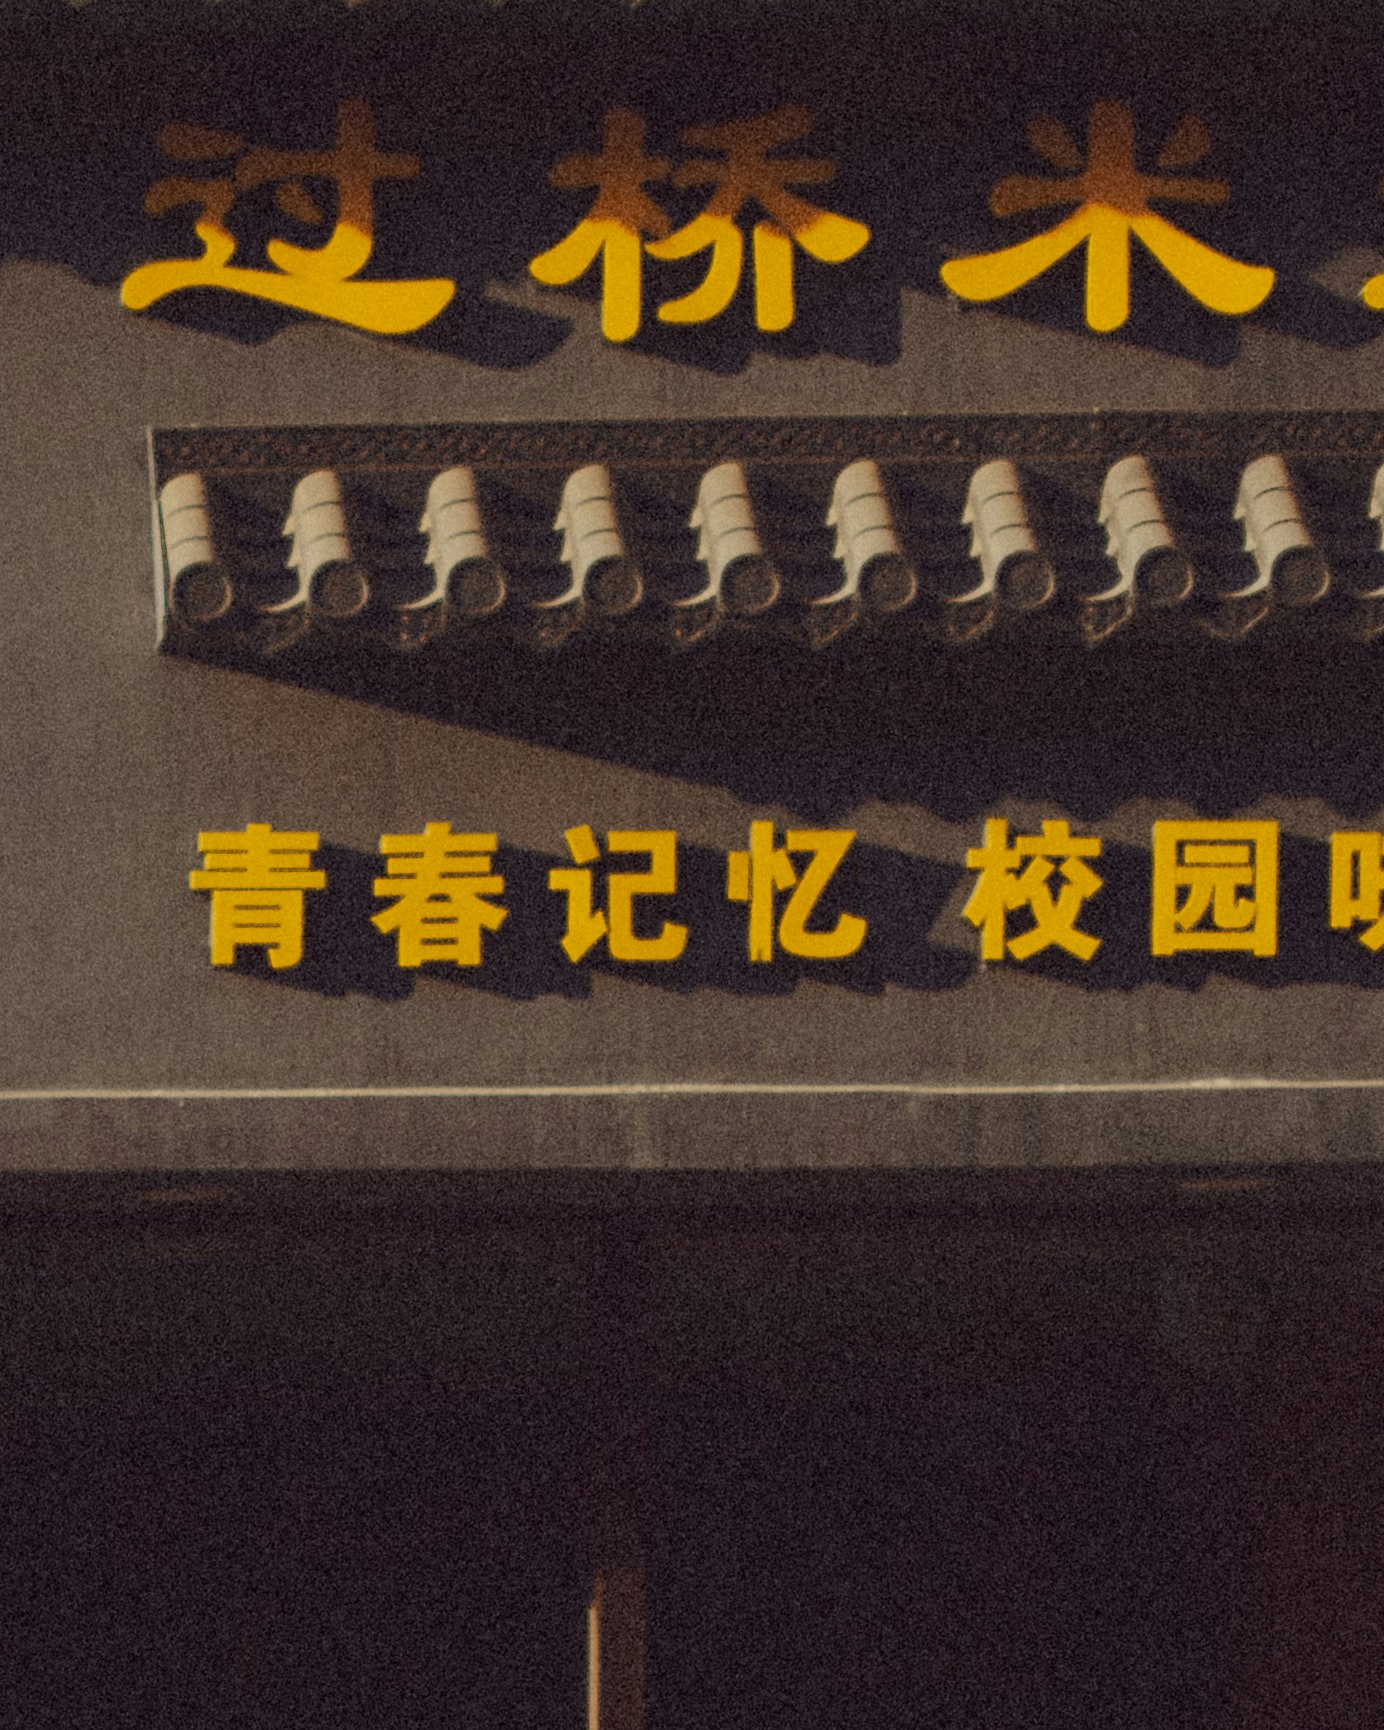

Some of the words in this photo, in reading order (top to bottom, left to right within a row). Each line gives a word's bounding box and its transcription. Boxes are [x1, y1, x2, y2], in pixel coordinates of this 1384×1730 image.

[120, 95, 1384, 341] 过桥米
[188, 819, 868, 968] 青春记忆
